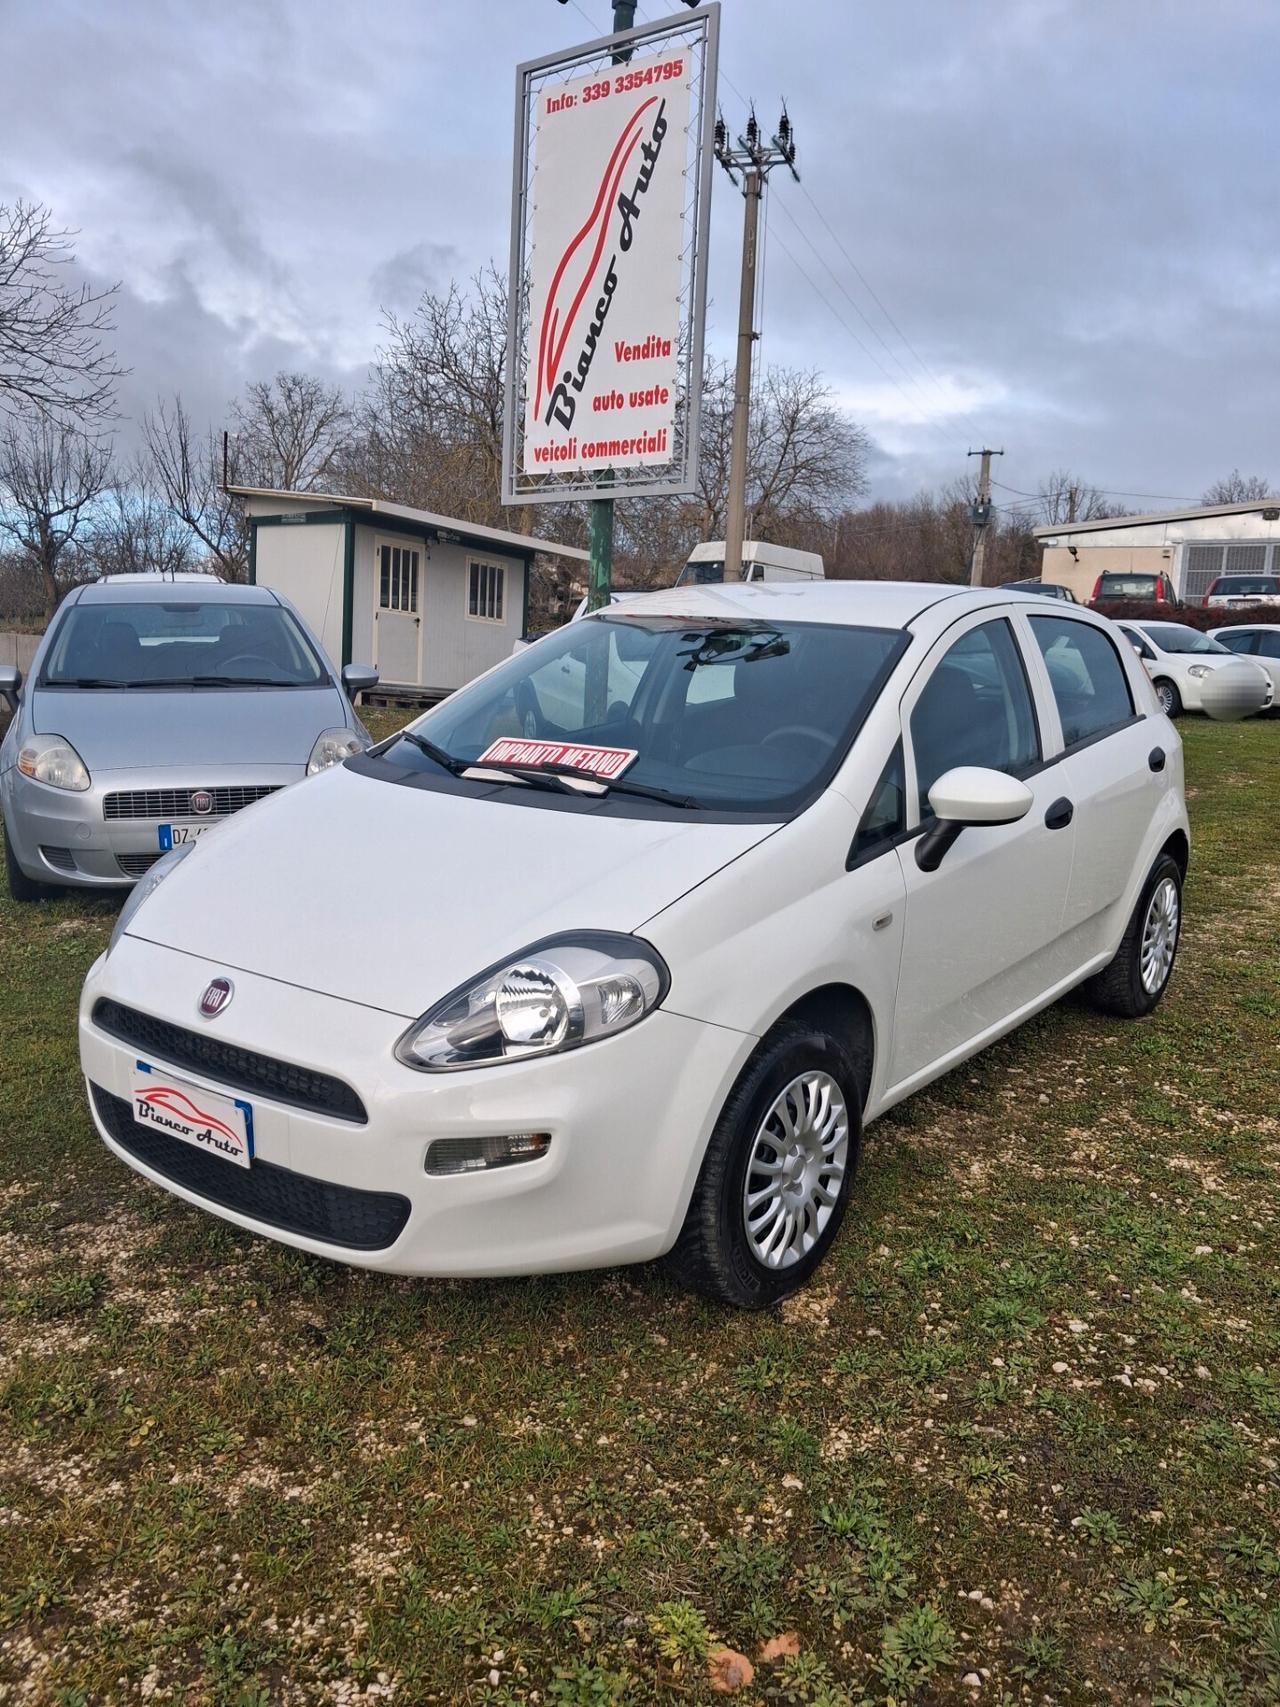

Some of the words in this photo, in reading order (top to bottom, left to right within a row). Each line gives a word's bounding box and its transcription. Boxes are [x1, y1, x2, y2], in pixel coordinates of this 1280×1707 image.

[546, 94, 578, 114] Info:
[582, 80, 611, 103] 339
[614, 59, 683, 95] 3354795
[545, 254, 618, 431] Bianco
[617, 98, 668, 252] Auto
[614, 335, 671, 362] Vendita
[592, 390, 624, 412] auto
[629, 385, 669, 407] usate
[534, 438, 577, 462] veicoli
[582, 428, 667, 459] commerciali
[205, 988, 226, 1007] FIAT
[136, 1098, 194, 1134] Bianco
[197, 1129, 243, 1157] Auto
